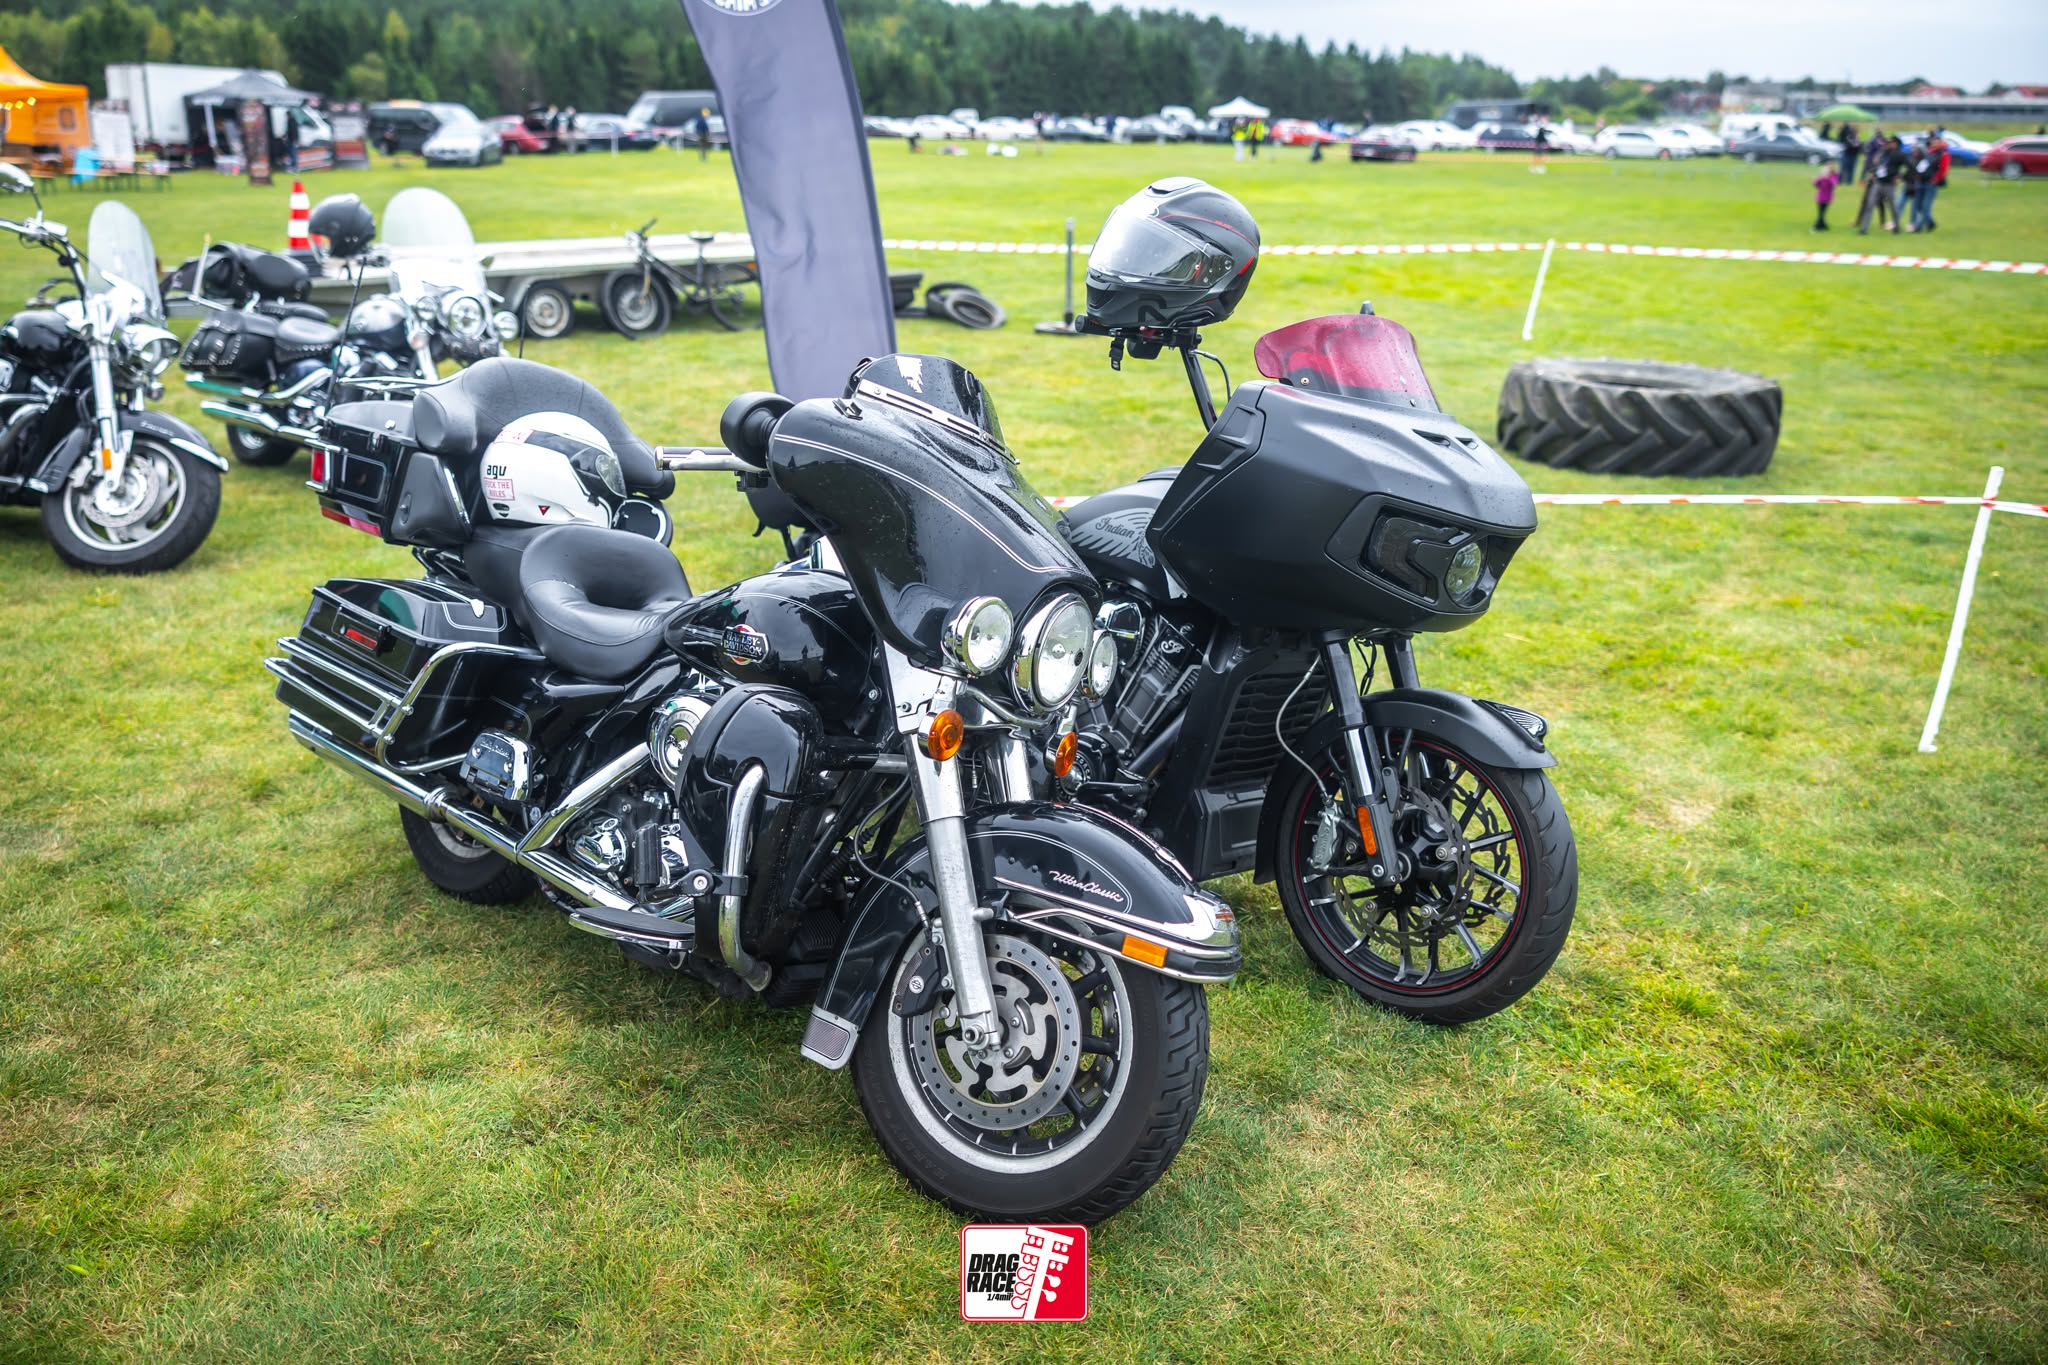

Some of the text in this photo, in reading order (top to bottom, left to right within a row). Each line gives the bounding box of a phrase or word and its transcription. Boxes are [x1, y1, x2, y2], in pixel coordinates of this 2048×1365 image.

[486, 465, 507, 480] agv
[1095, 517, 1135, 539] Indian
[723, 639, 762, 656] DAVIDSON
